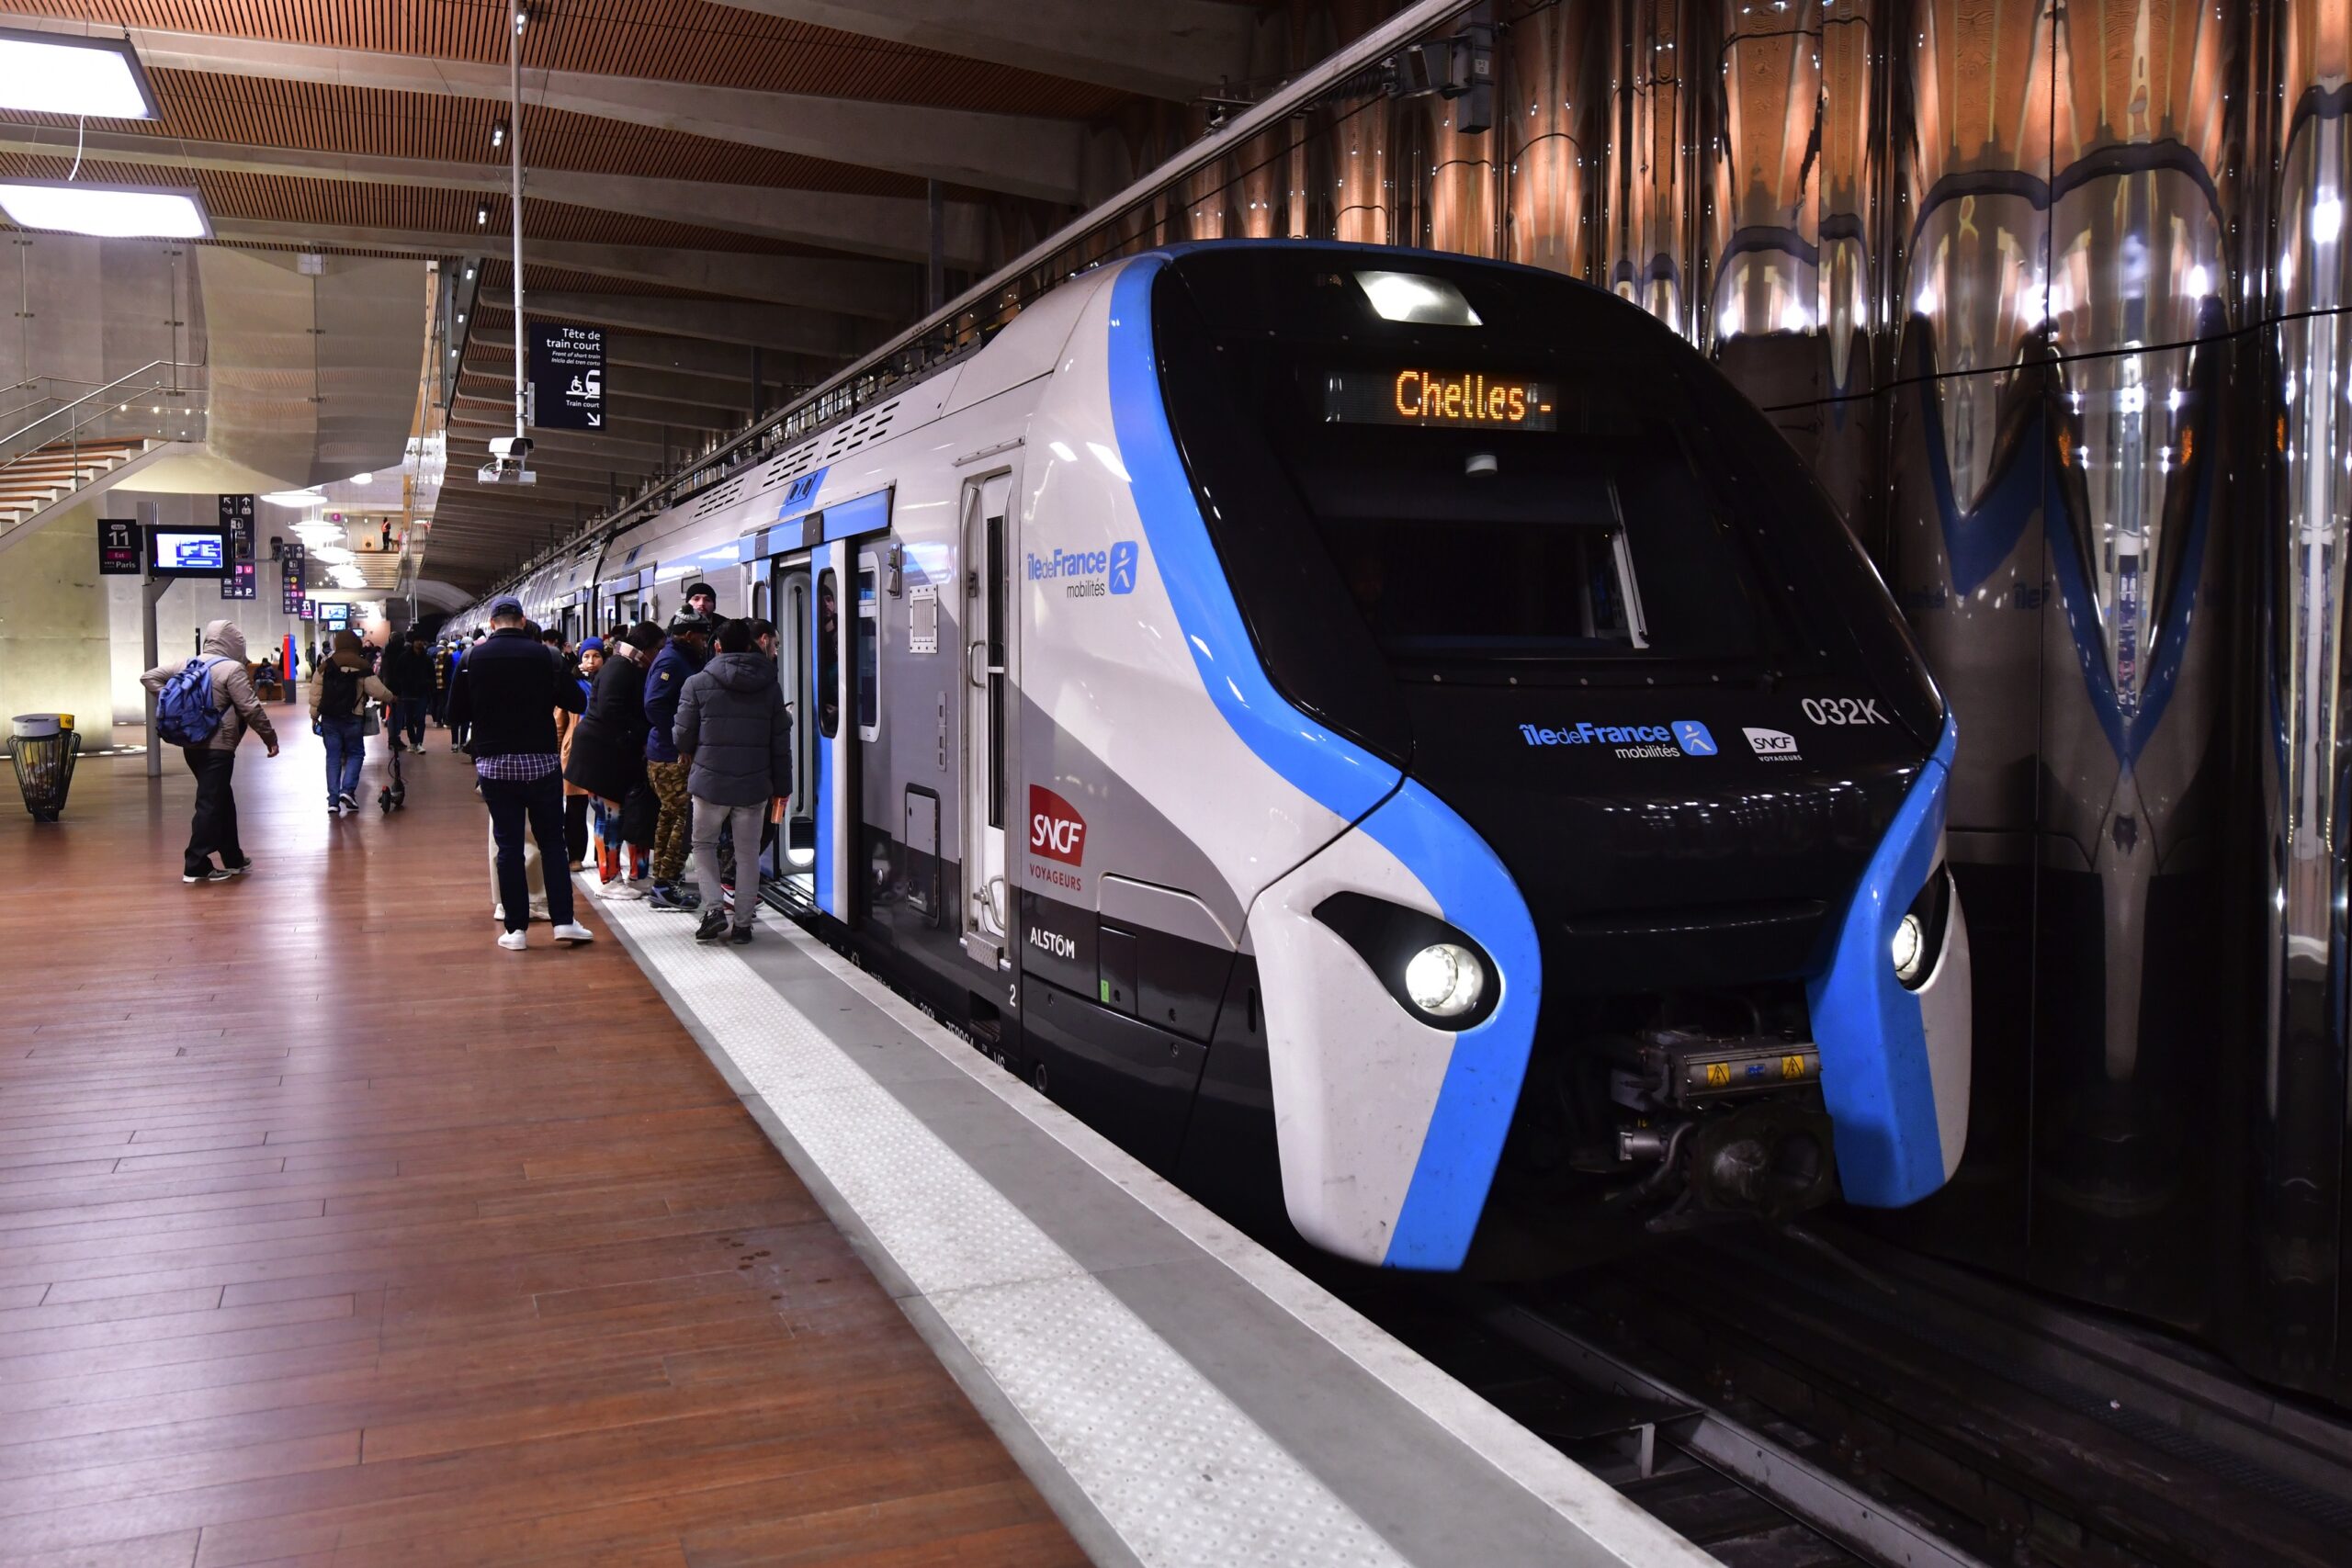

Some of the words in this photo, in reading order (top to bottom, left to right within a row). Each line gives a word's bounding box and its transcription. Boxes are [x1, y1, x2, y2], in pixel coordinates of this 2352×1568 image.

[562, 328, 585, 339] Tête
[588, 331, 601, 341] de
[547, 338, 571, 349] train
[573, 342, 601, 351] court
[1396, 370, 1525, 421] Chelles
[108, 531, 129, 546] 11
[116, 560, 136, 569] Paris
[1067, 578, 1105, 599] mobilités
[1801, 697, 1890, 726] 032K
[1615, 743, 1680, 760] mobilités
[1753, 737, 1792, 750] SNCF
[1758, 754, 1803, 762] VOYAGEURS
[1031, 814, 1082, 854] SNCF
[1029, 863, 1082, 891] VOYAGEURS
[1029, 926, 1076, 959] ALSTOM
[1010, 984, 1016, 1007] 2
